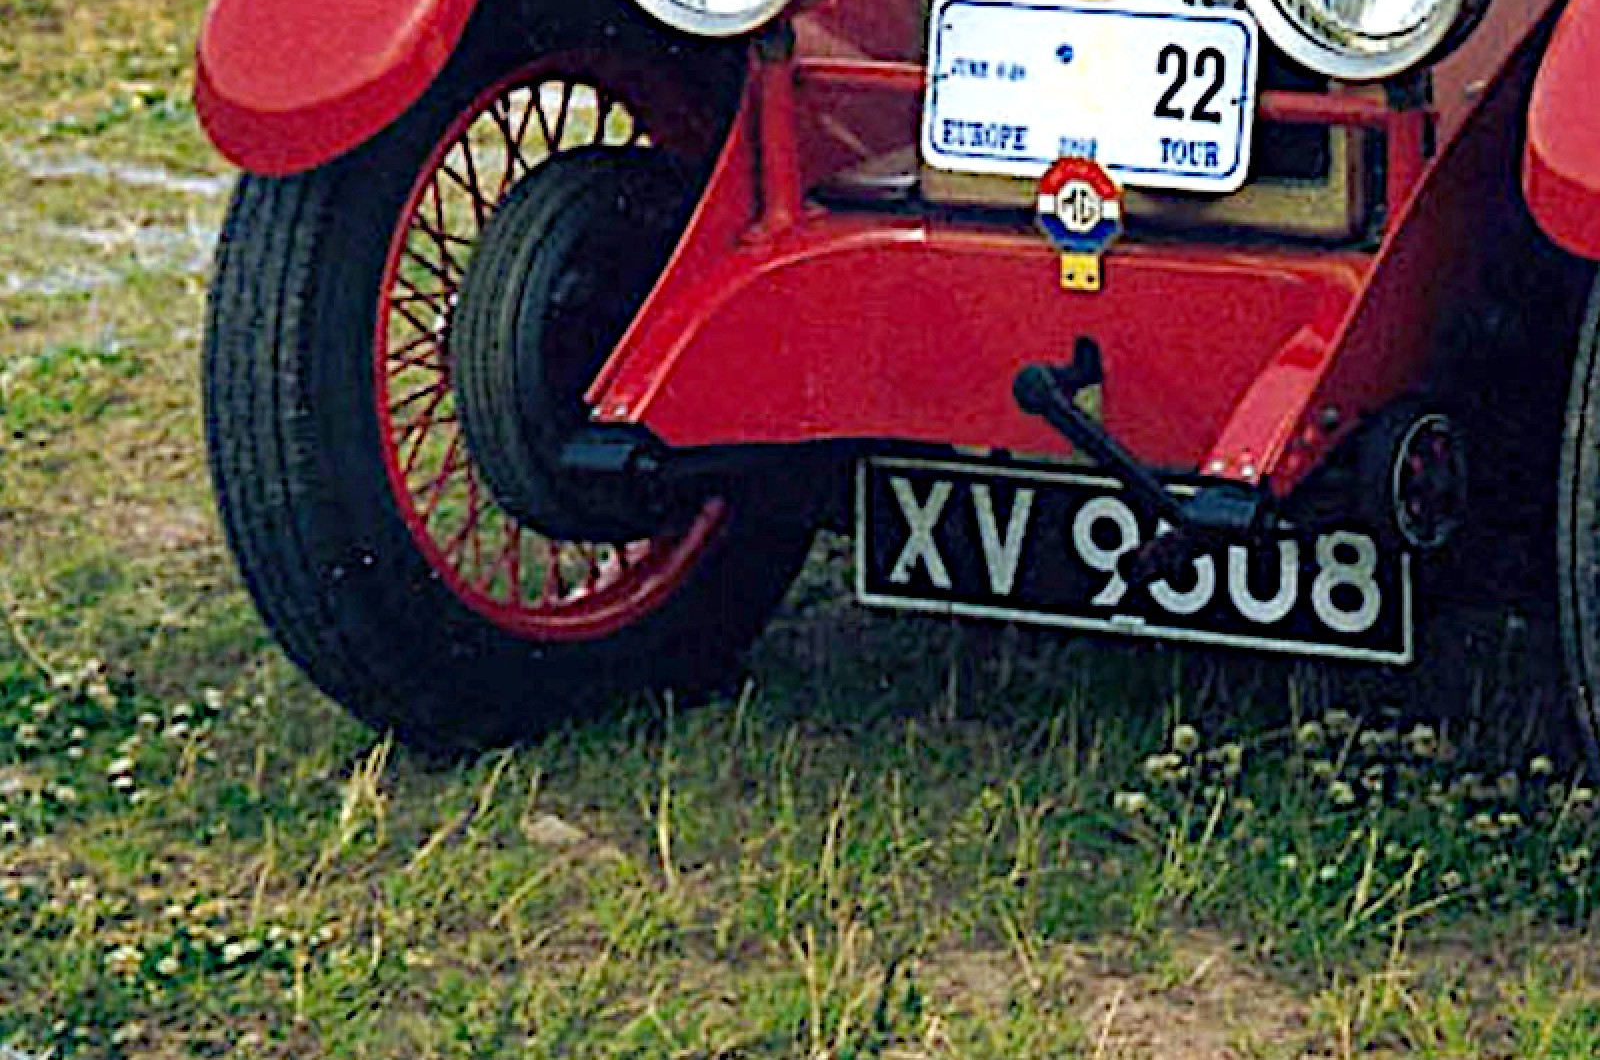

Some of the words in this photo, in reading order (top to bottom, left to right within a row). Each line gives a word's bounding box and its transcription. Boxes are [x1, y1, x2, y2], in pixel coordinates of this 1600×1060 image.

[1154, 43, 1226, 124] 22
[943, 118, 1029, 152] EUROPE
[1159, 137, 1219, 168] TOUR
[1060, 187, 1100, 224] MG
[889, 476, 1036, 597] XV
